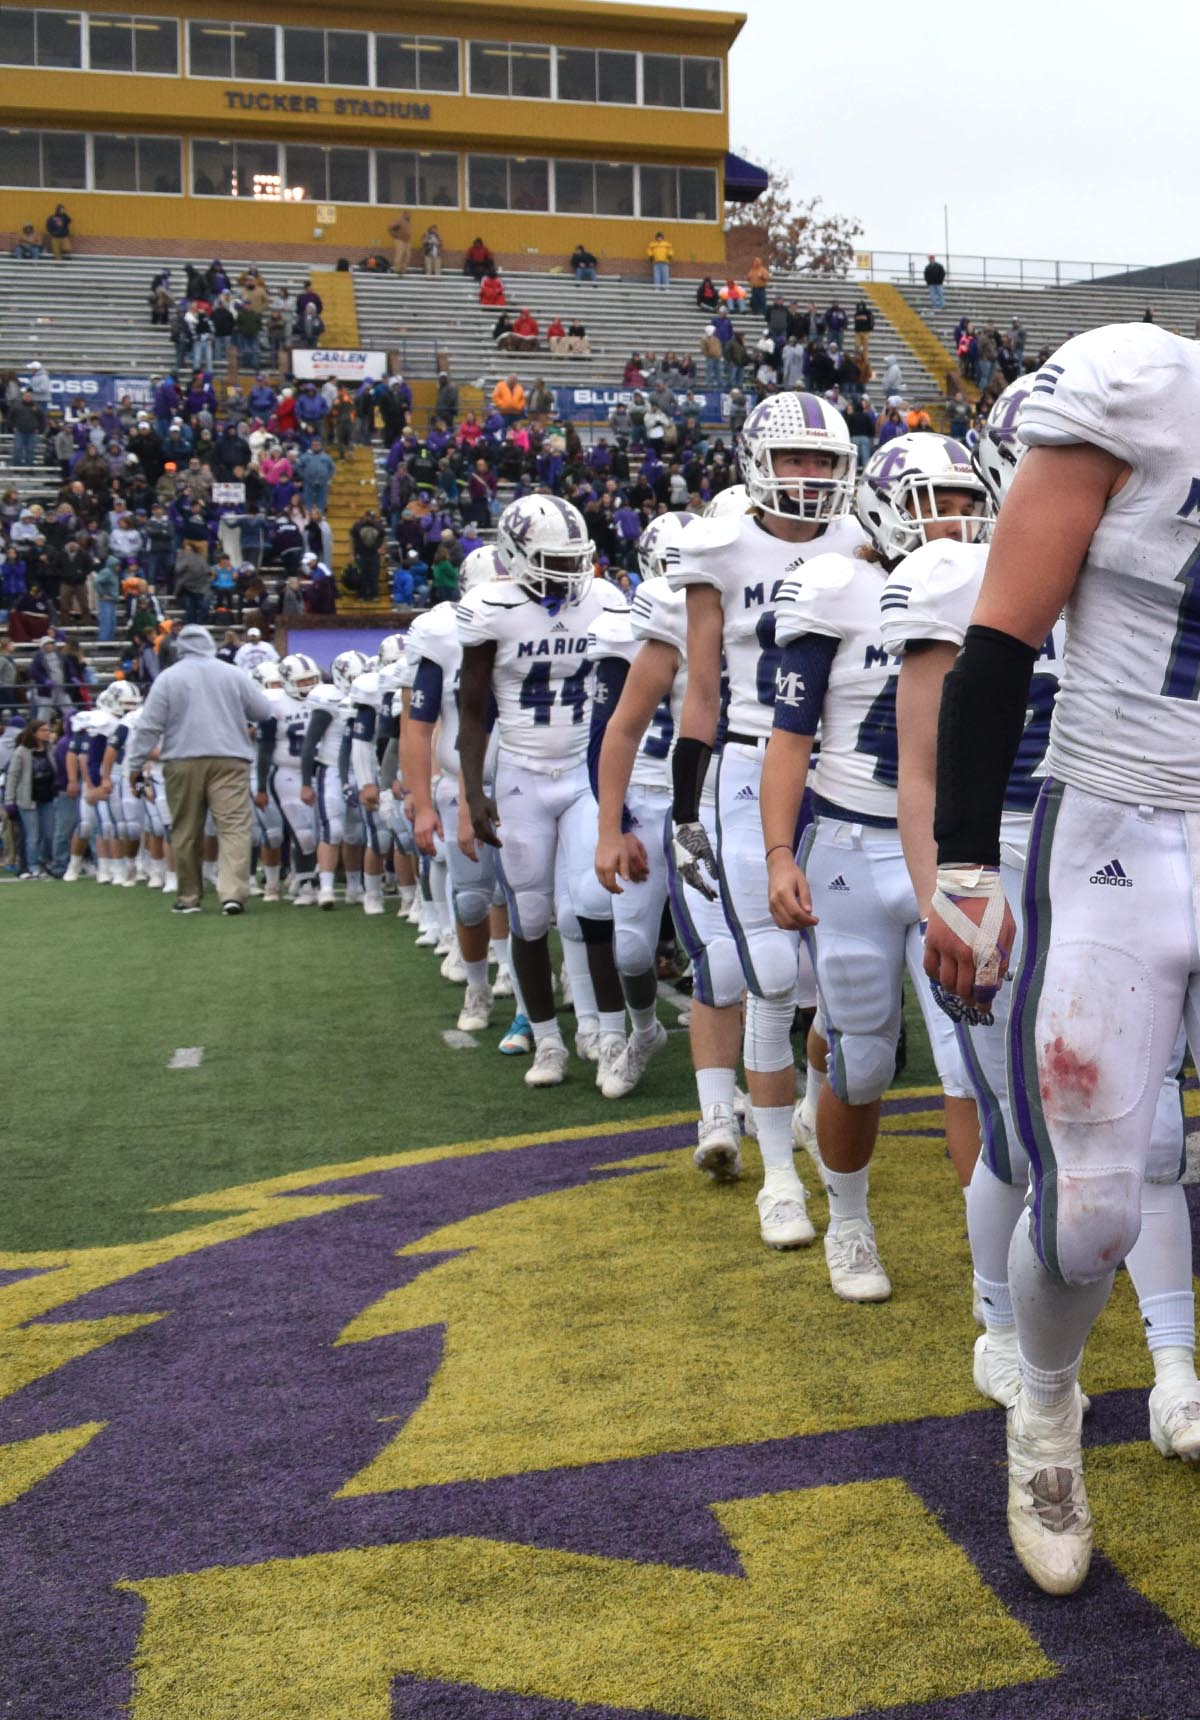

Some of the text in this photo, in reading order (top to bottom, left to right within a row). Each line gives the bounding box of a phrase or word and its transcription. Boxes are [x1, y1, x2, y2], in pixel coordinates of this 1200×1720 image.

[224, 91, 432, 120] TUCKER STADIUM
[311, 351, 367, 363] CARLEN
[517, 637, 588, 658] MARIO
[518, 658, 595, 726] 44
[1089, 875, 1133, 888] adidas
